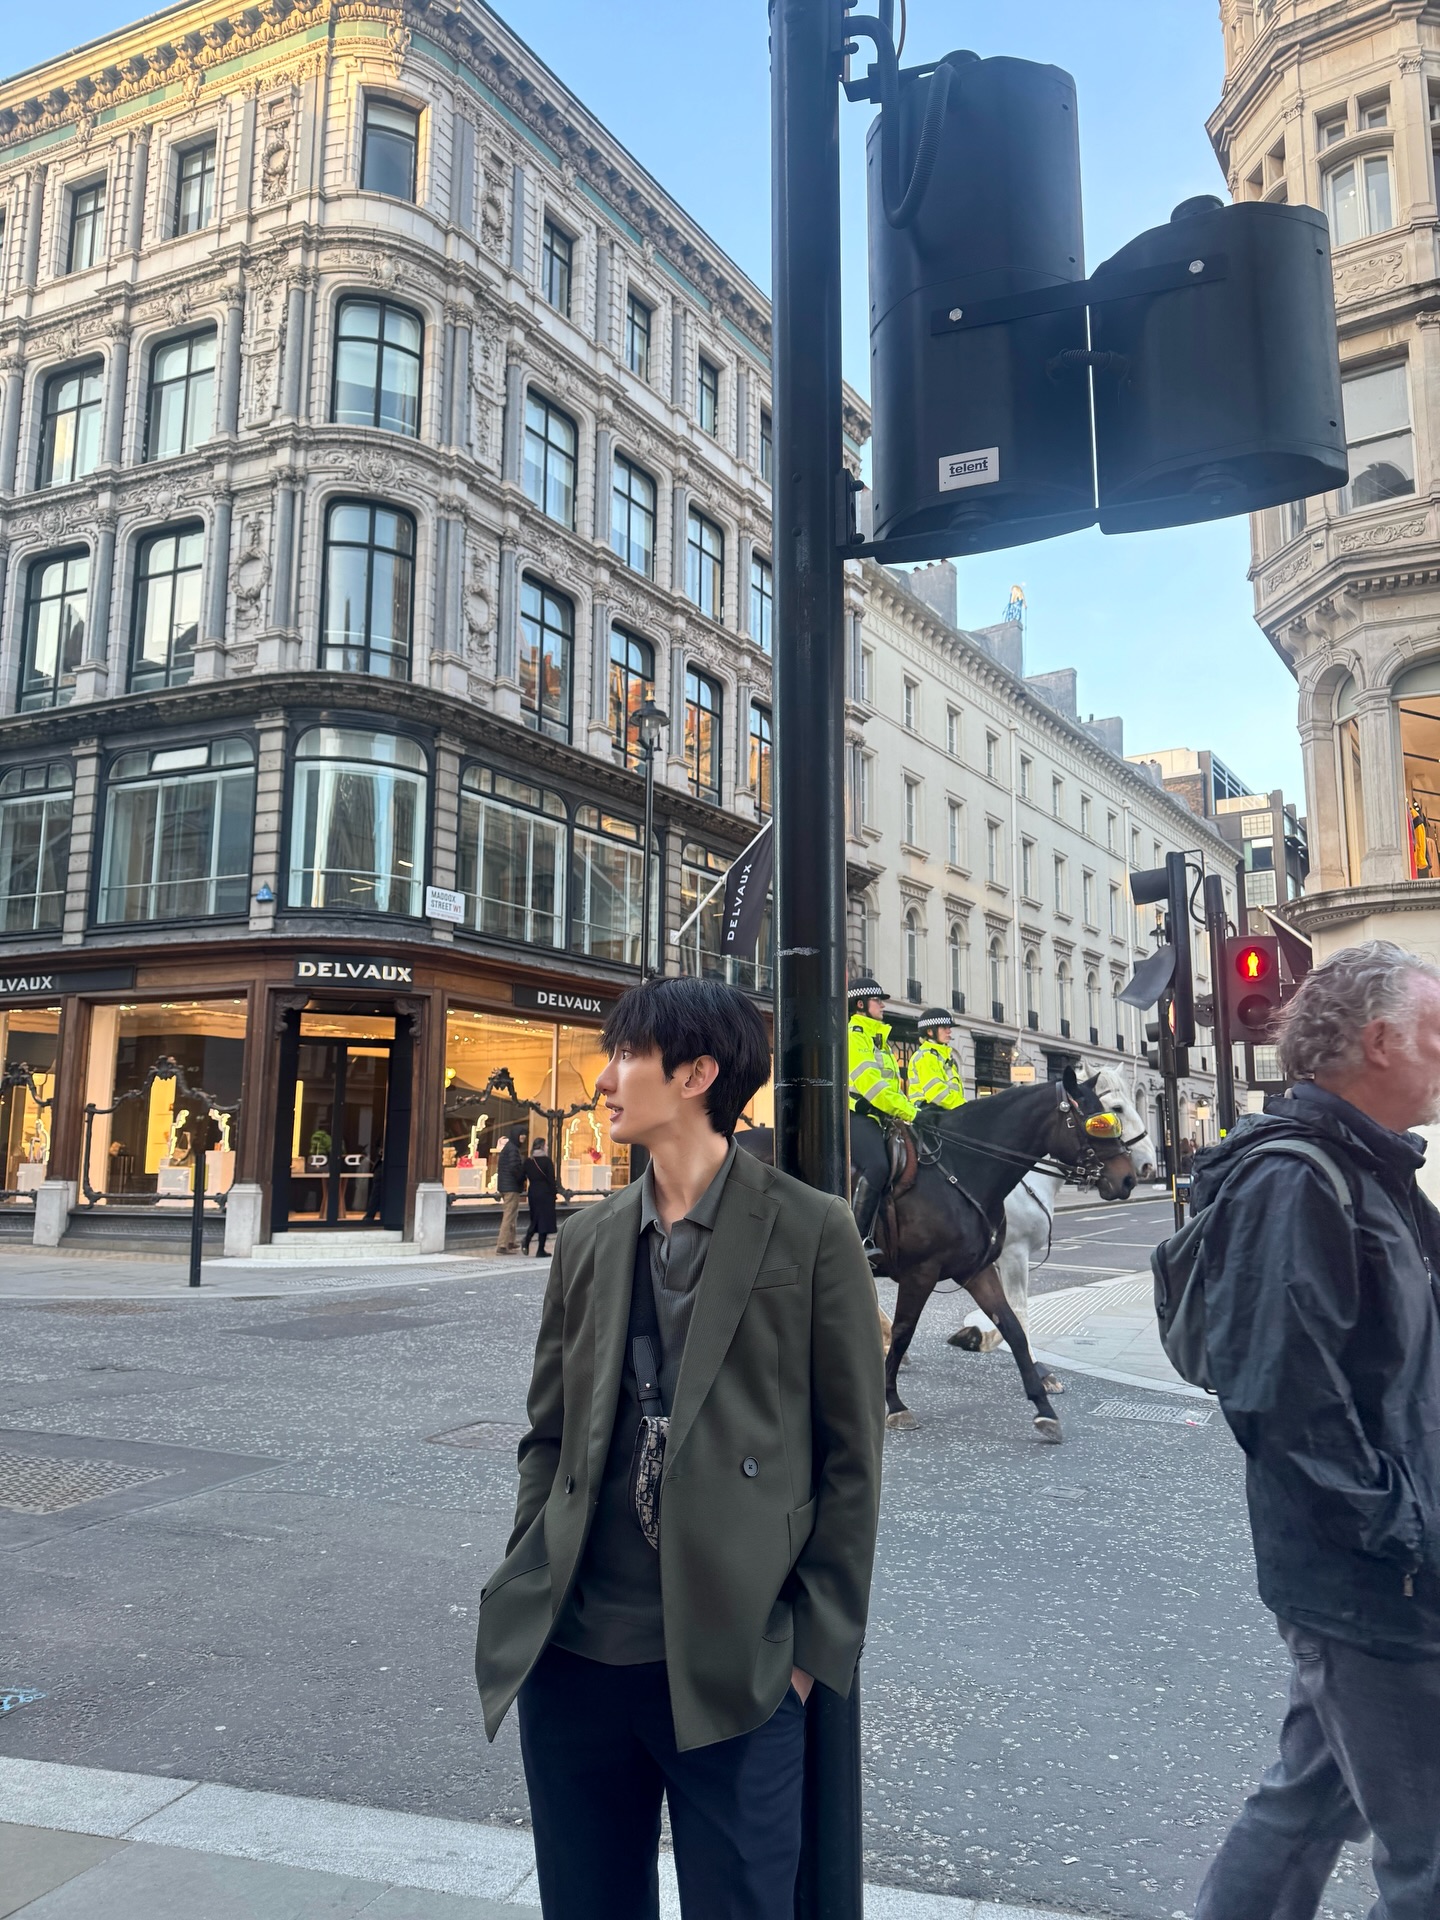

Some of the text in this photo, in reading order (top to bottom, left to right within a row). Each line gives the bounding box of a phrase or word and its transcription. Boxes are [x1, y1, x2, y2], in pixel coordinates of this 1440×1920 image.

[949, 460, 988, 474] telent
[431, 890, 456, 903] MADDOX
[726, 863, 752, 941] DELVAUX
[431, 900, 452, 911] STREET
[298, 962, 412, 982] DELVAUX
[537, 991, 601, 1012] DELVAUX
